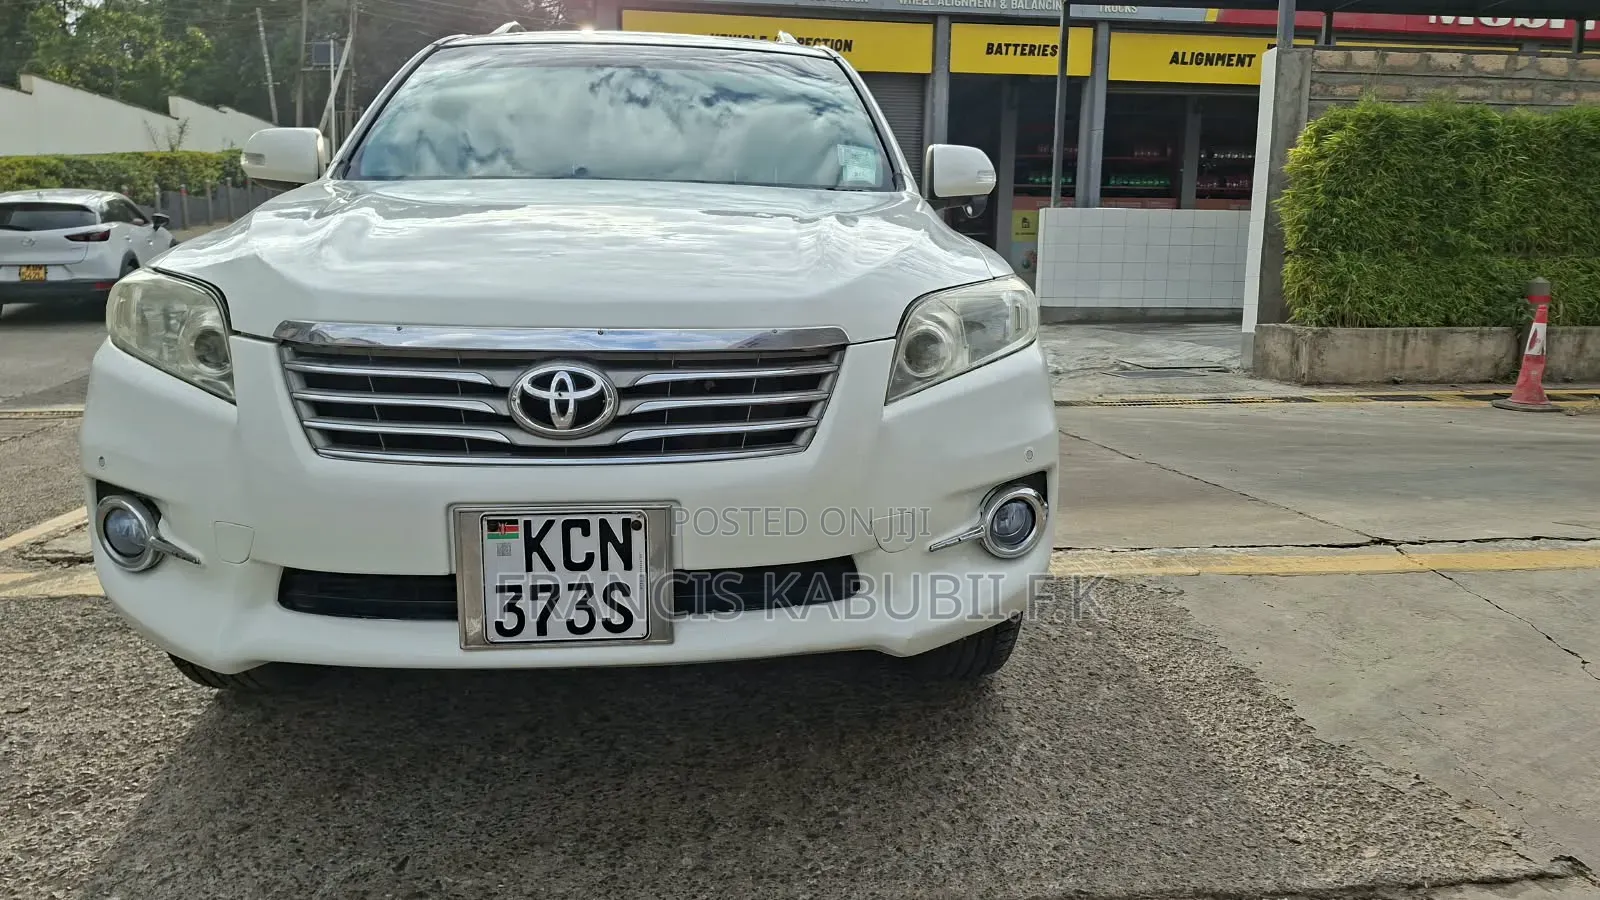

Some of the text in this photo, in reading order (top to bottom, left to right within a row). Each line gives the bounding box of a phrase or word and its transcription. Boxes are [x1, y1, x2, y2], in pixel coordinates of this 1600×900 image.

[1000, 0, 1008, 9] &
[1011, 0, 1062, 11] BALANCIN
[1100, 5, 1138, 13] TRUCKS
[985, 42, 1059, 57] BATTERIES
[1169, 51, 1256, 68] ALIGNMENT
[523, 517, 633, 572] KCN
[494, 581, 634, 637] 373S
